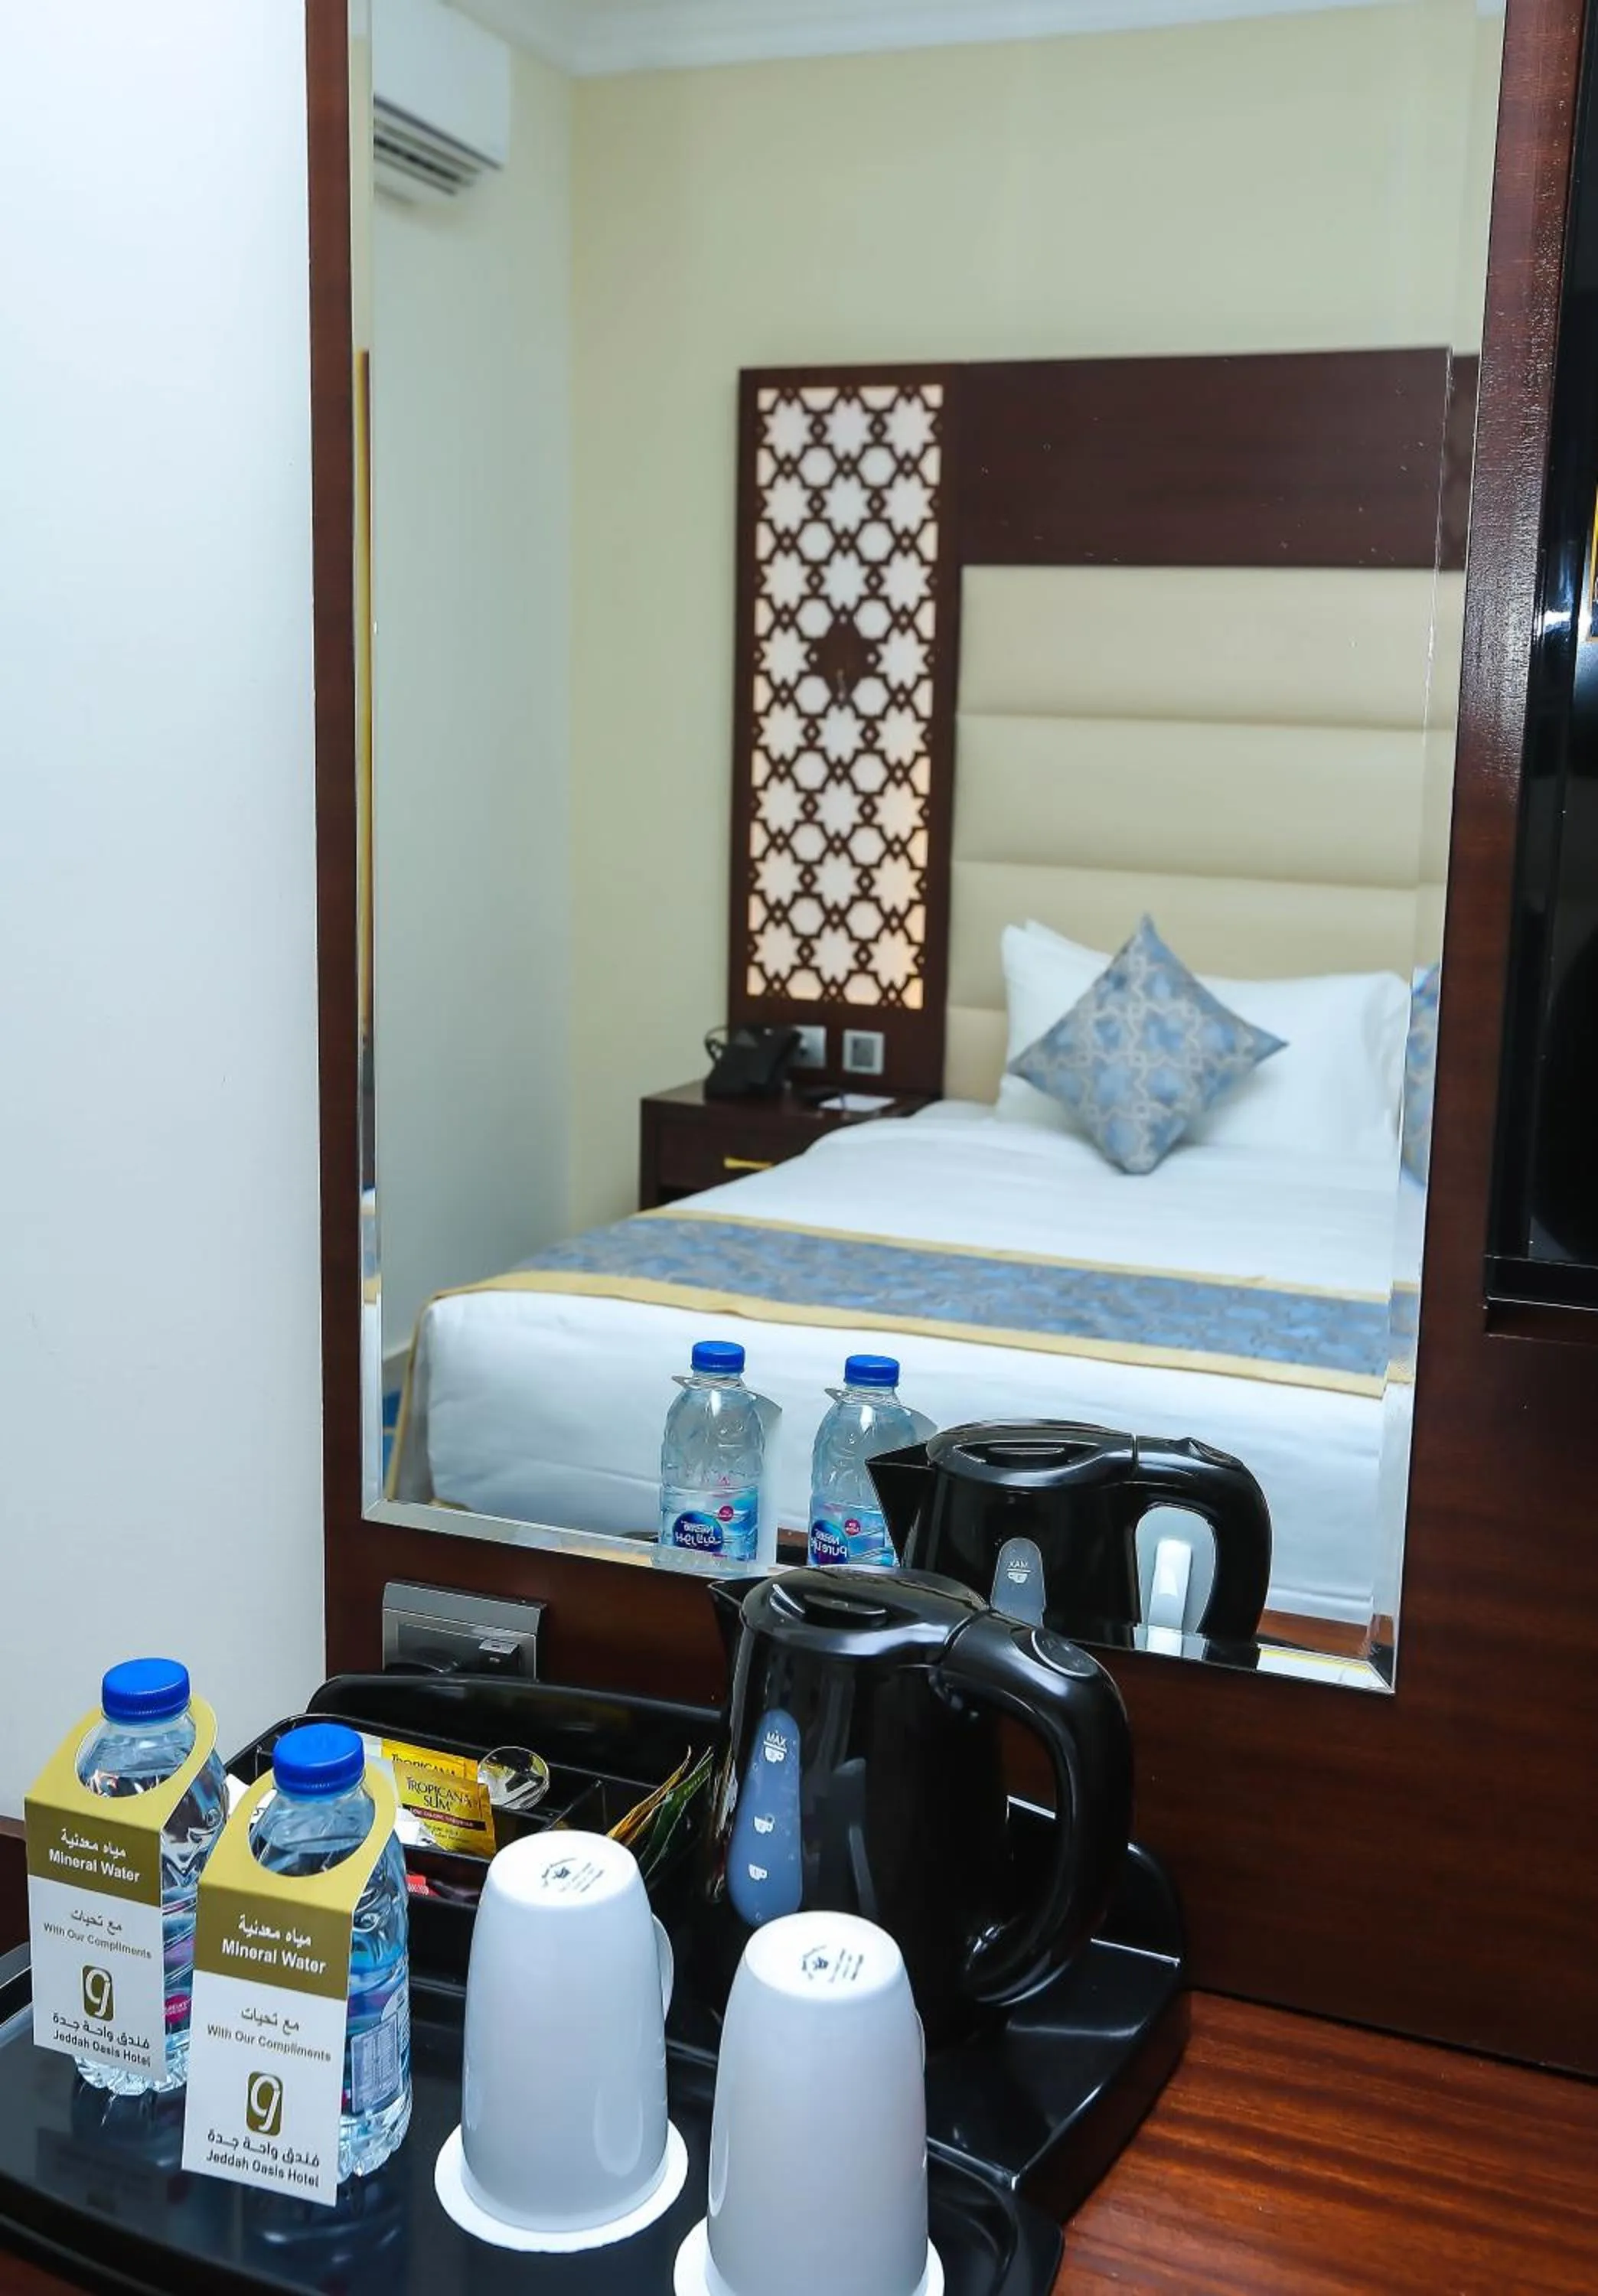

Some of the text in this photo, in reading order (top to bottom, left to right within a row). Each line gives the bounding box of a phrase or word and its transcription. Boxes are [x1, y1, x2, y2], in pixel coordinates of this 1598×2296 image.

[766, 1730, 786, 1749] MAX
[406, 1776, 472, 1808] TROPICANA
[423, 1793, 451, 1812] SLIM
[60, 1828, 126, 1859] مياه معدنية
[48, 1848, 140, 1883] Mineral Water
[44, 1922, 152, 1959] With Our Compliments
[70, 1910, 122, 1936] مع تحيات
[238, 1913, 312, 1949] مياه معدنية
[221, 1938, 327, 1975] Mineral Water
[241, 2007, 300, 2036] مع تحيات
[53, 2030, 151, 2067] Jeddah Oasis Hotel
[207, 2023, 331, 2062] With Our Compliments
[206, 2149, 320, 2188] Jeddah Oasis Hotel
